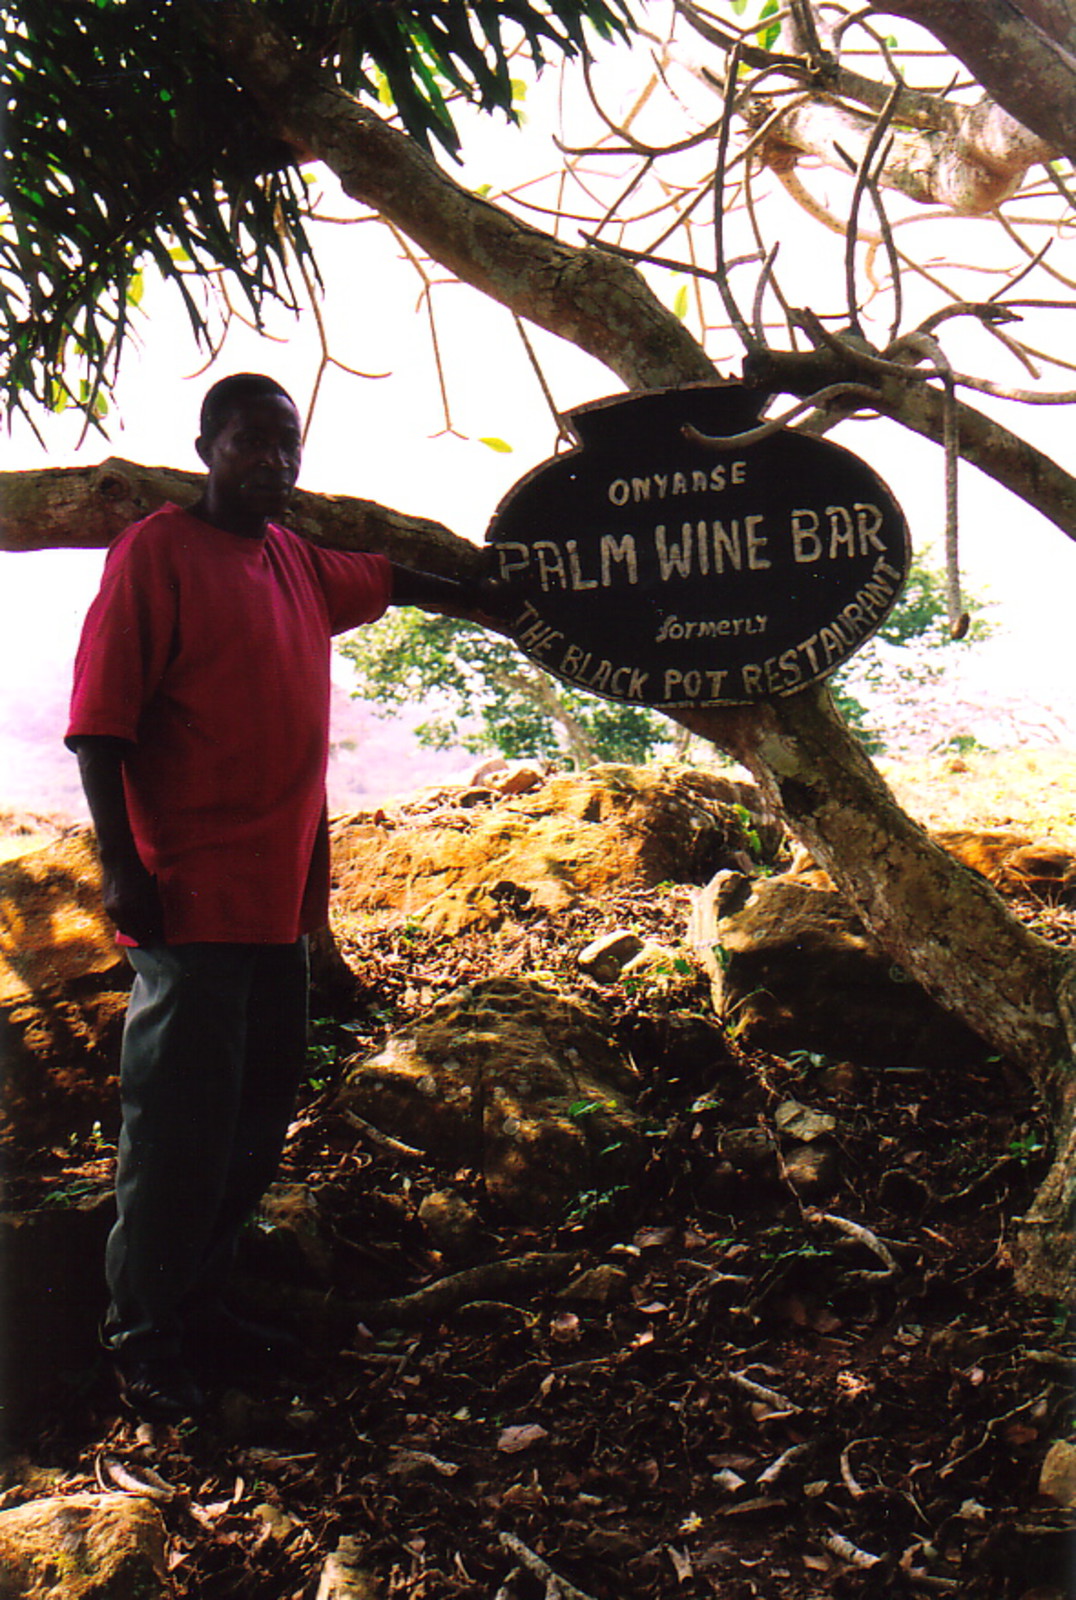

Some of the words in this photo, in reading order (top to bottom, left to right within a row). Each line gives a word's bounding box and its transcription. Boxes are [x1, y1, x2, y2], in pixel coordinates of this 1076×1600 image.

[495, 533, 638, 592] PALM
[655, 513, 772, 581] WINE
[790, 502, 888, 563] BAR
[512, 600, 565, 657] THE
[559, 643, 649, 699] BLACK
[663, 668, 729, 700] POT
[741, 555, 902, 695] RESTAURANT
